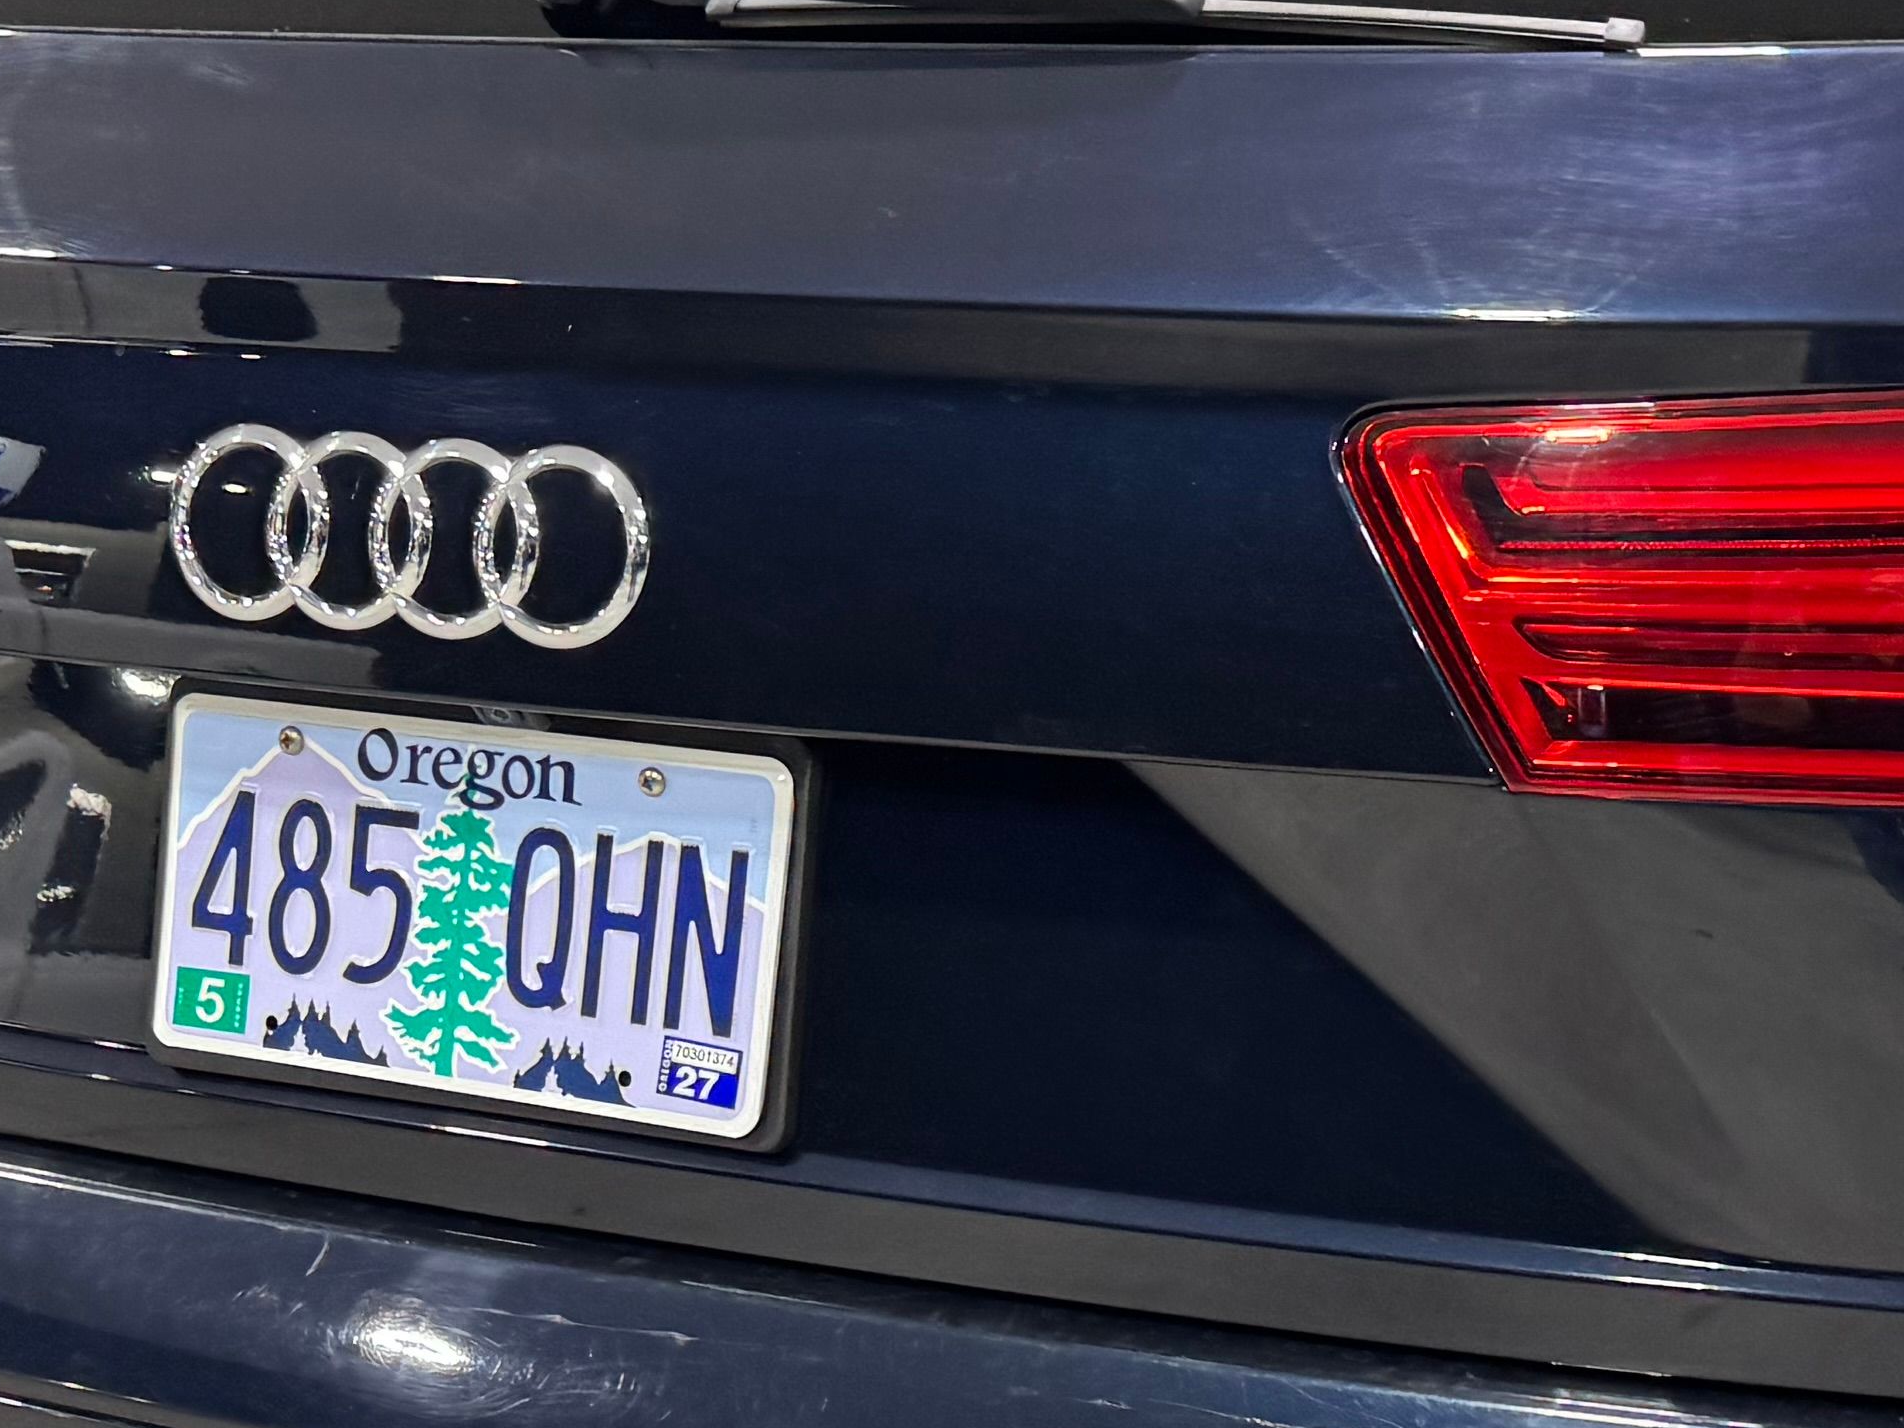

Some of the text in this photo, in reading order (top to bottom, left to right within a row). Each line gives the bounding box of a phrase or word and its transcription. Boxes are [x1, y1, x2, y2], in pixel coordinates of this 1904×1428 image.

[357, 728, 582, 810] Oregon
[192, 791, 750, 1038] 485 QHN
[196, 977, 225, 1023] 5
[675, 1044, 735, 1067] 70301374
[672, 1066, 720, 1100] 27
